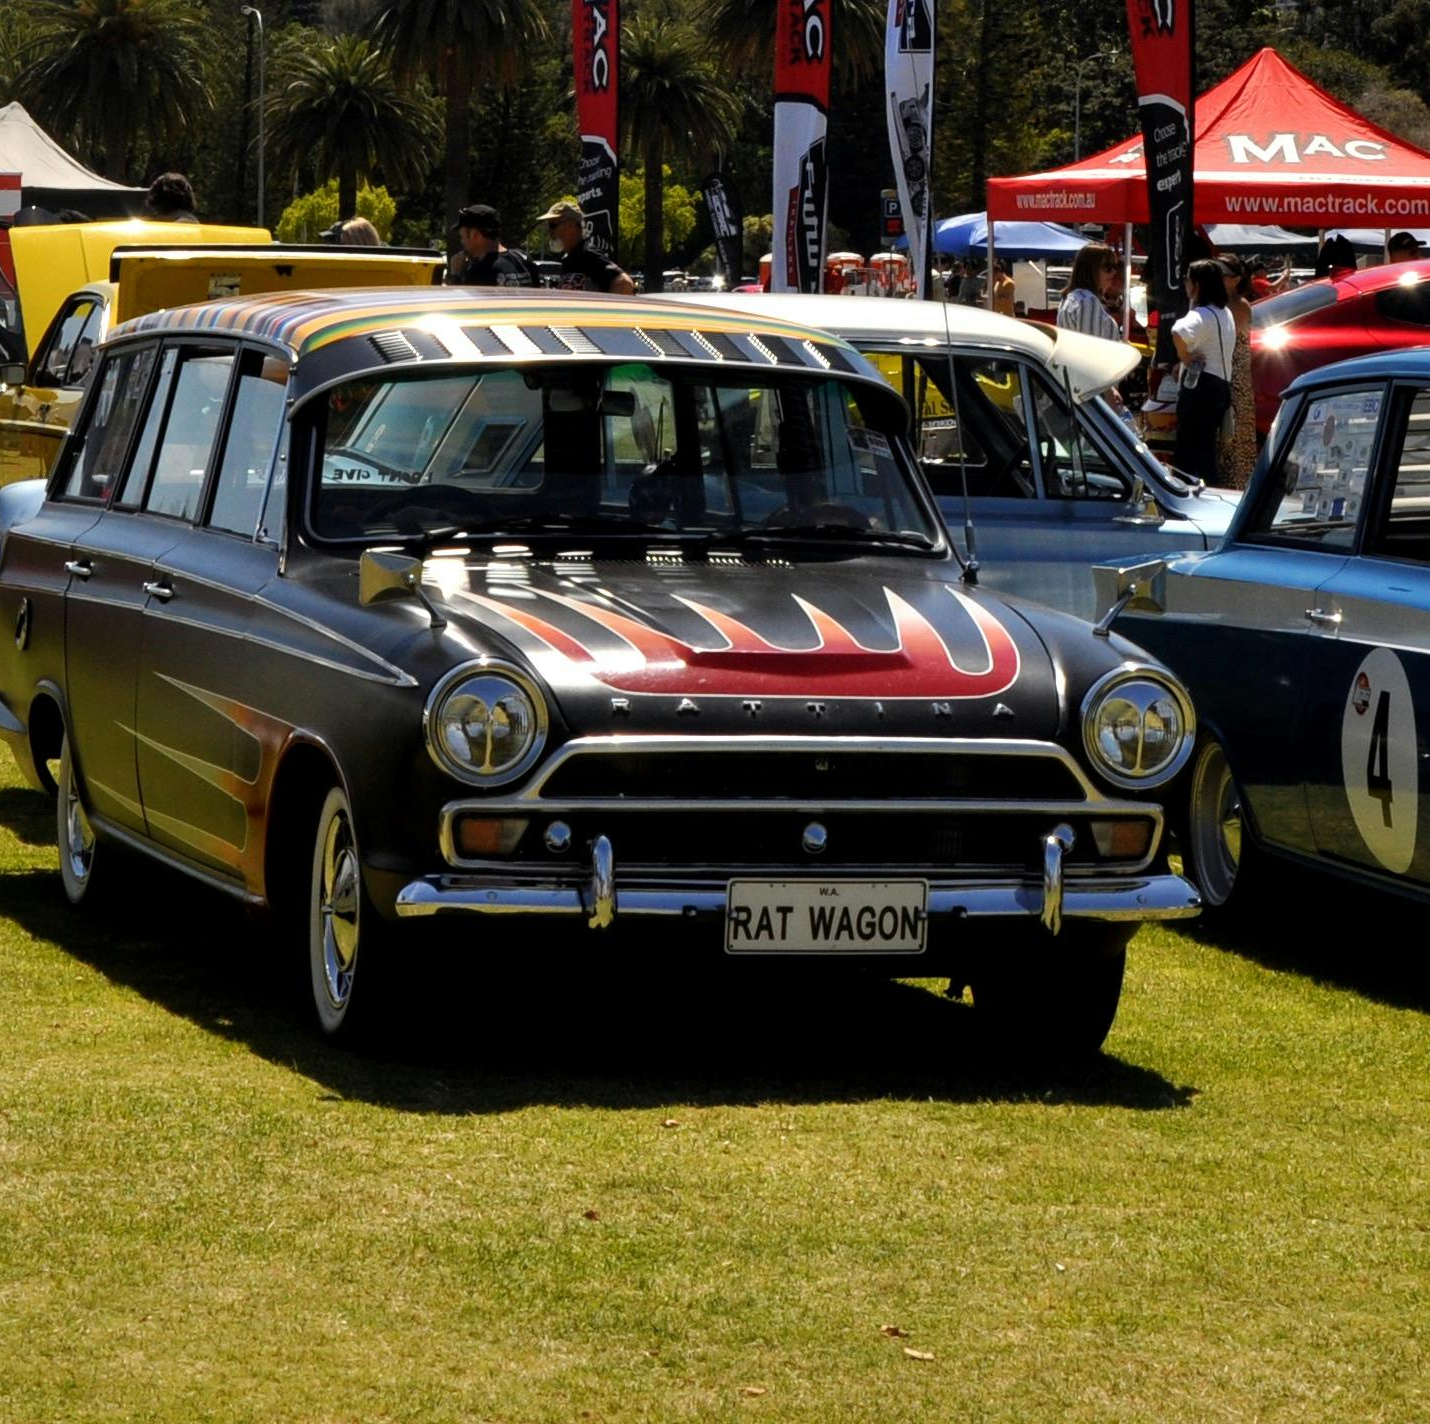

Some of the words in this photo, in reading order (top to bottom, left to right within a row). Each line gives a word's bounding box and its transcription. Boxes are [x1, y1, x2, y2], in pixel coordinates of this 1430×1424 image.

[1227, 134, 1387, 163] MAC
[886, 201, 900, 216] P
[1017, 190, 1096, 209] www.mactrack.com.au
[610, 697, 1016, 720] RATTINA
[1367, 690, 1394, 829] 4
[732, 905, 794, 941] RAT
[809, 905, 919, 941] WAGON
